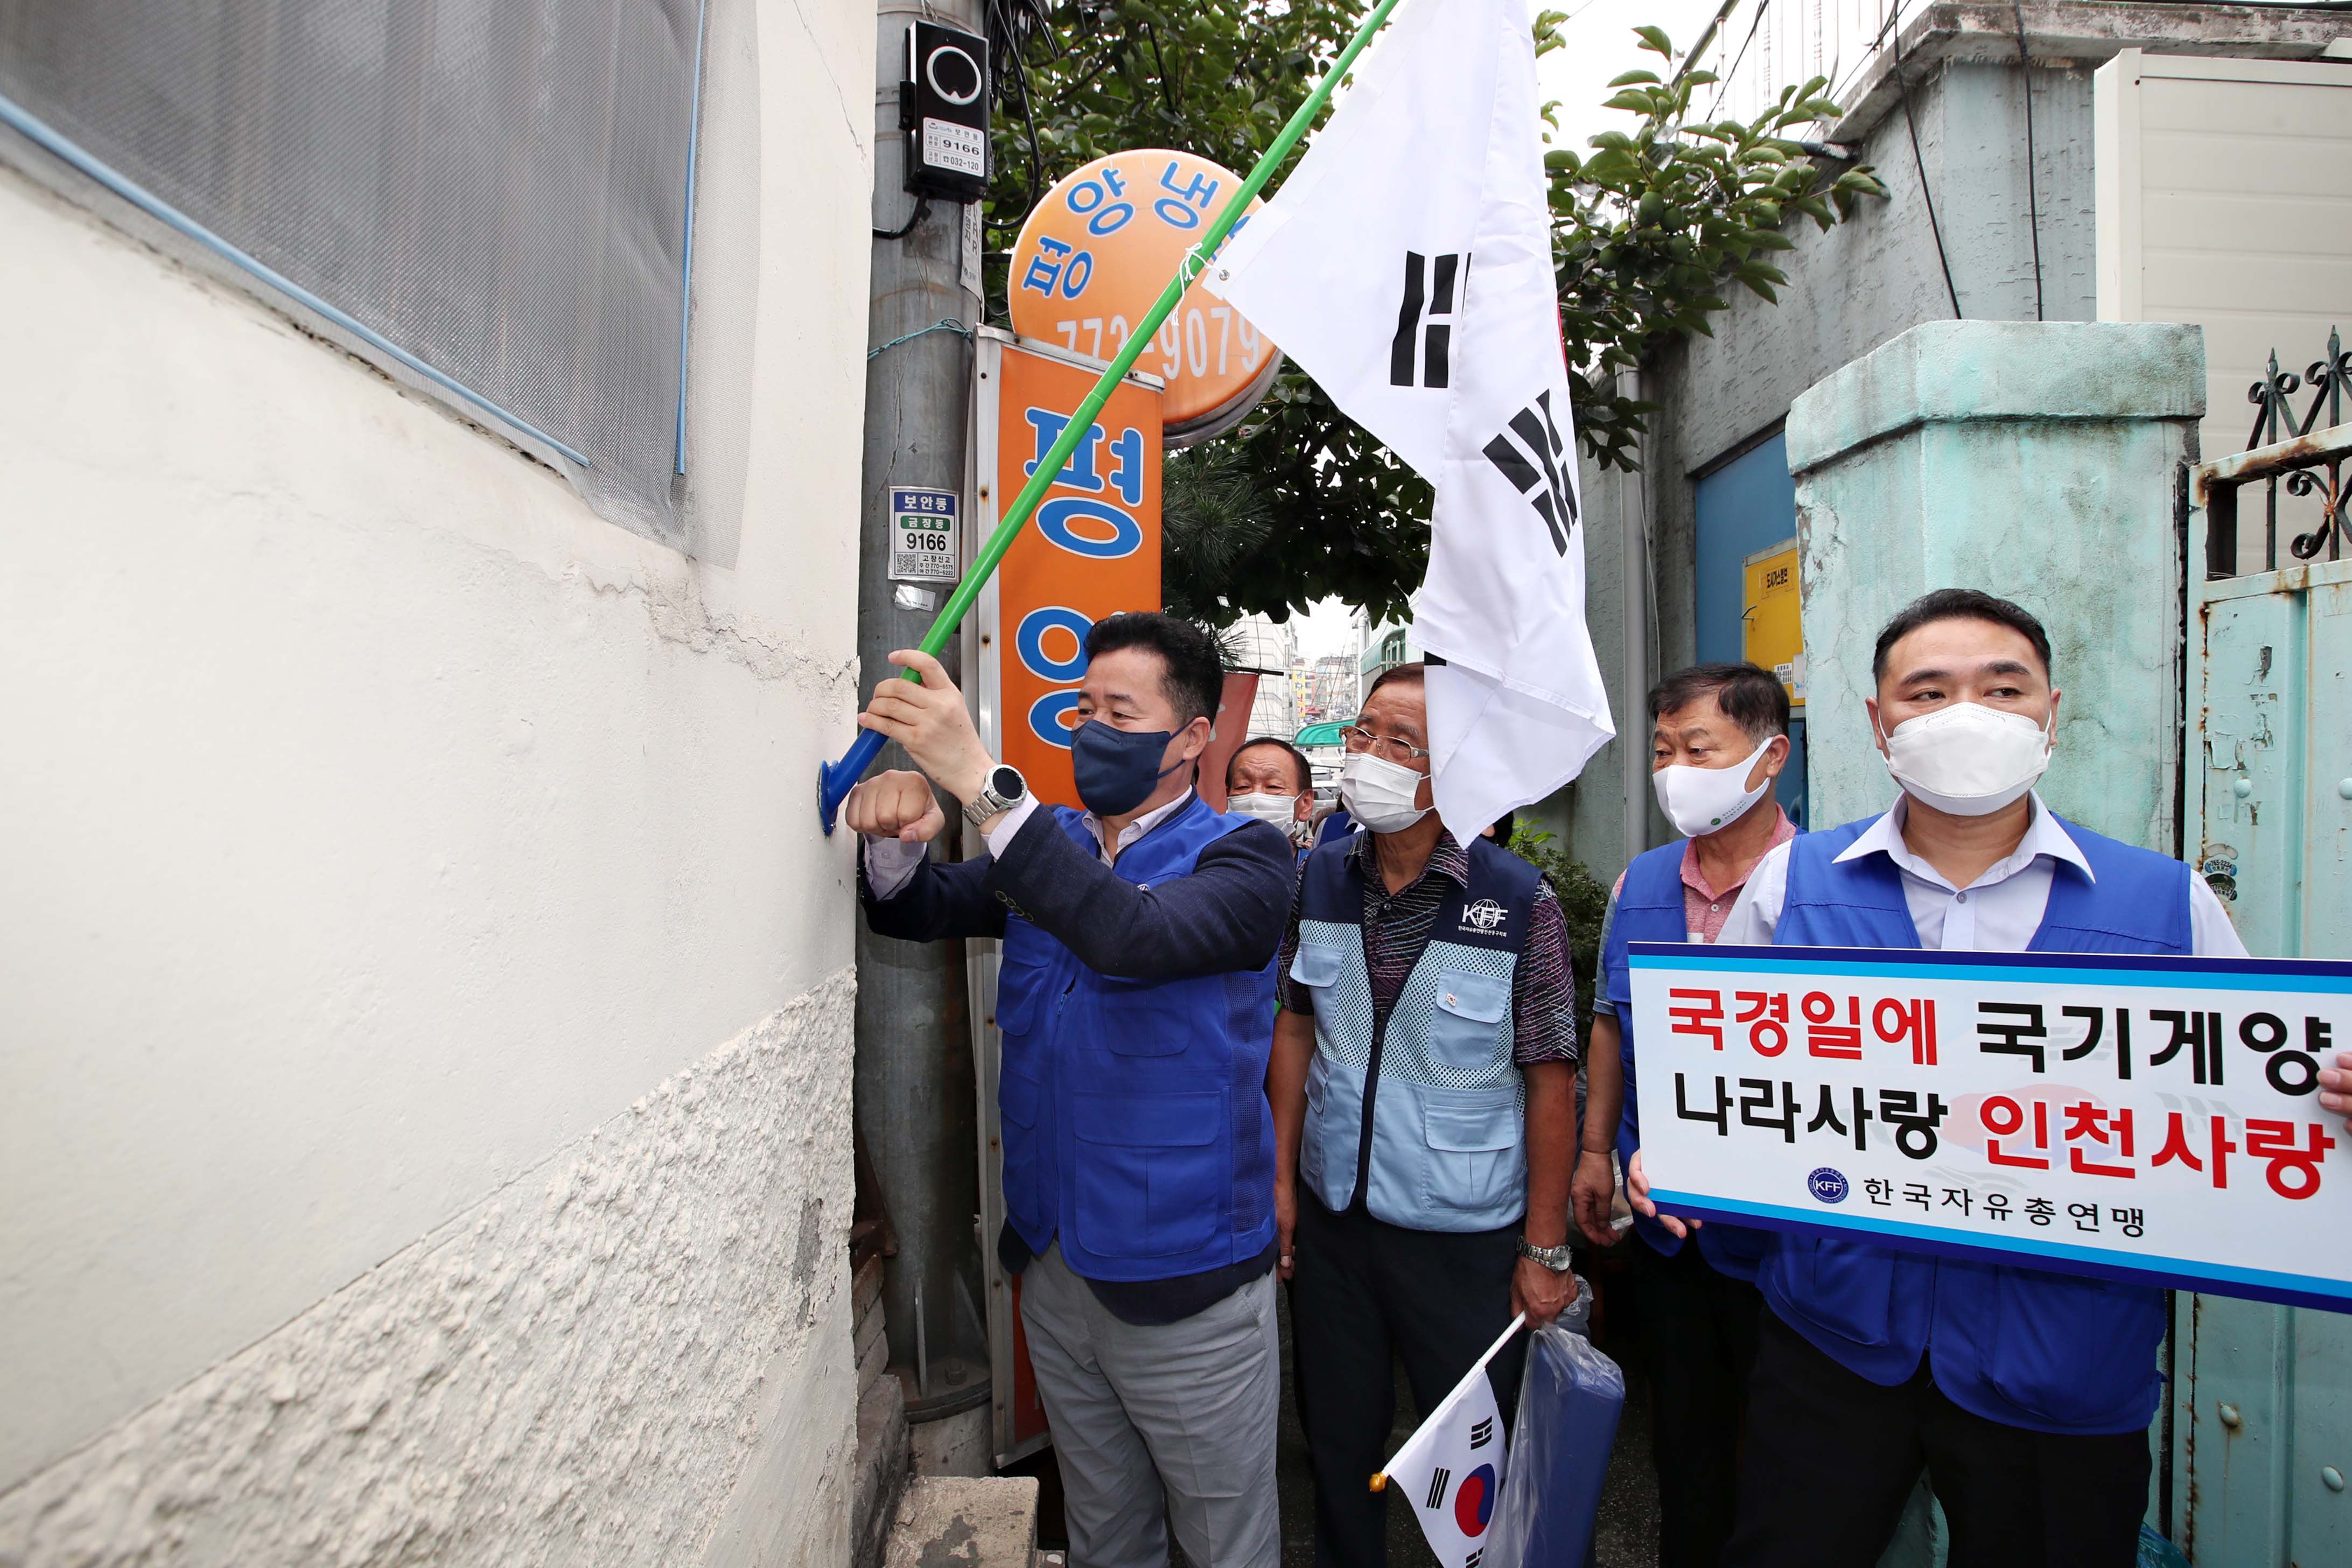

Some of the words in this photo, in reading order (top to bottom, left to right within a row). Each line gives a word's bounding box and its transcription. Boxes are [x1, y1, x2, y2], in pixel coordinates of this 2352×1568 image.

[943, 139, 979, 155] 9166
[950, 156, 979, 171] 032-120
[1023, 161, 1251, 299] 평양냉
[904, 494, 948, 511] 보안등
[907, 533, 946, 551] 9166
[922, 555, 951, 563] 고장신고
[1462, 904, 1508, 927] KFF
[1669, 988, 1938, 1066] 국경일에
[1977, 1002, 2332, 1097] 국기게양
[1675, 1072, 1948, 1160] 나라사랑
[1979, 1095, 2335, 1200] 인천사랑
[1815, 1179, 1842, 1193] KFF
[1864, 1177, 2145, 1239] 한국자유총연맹
